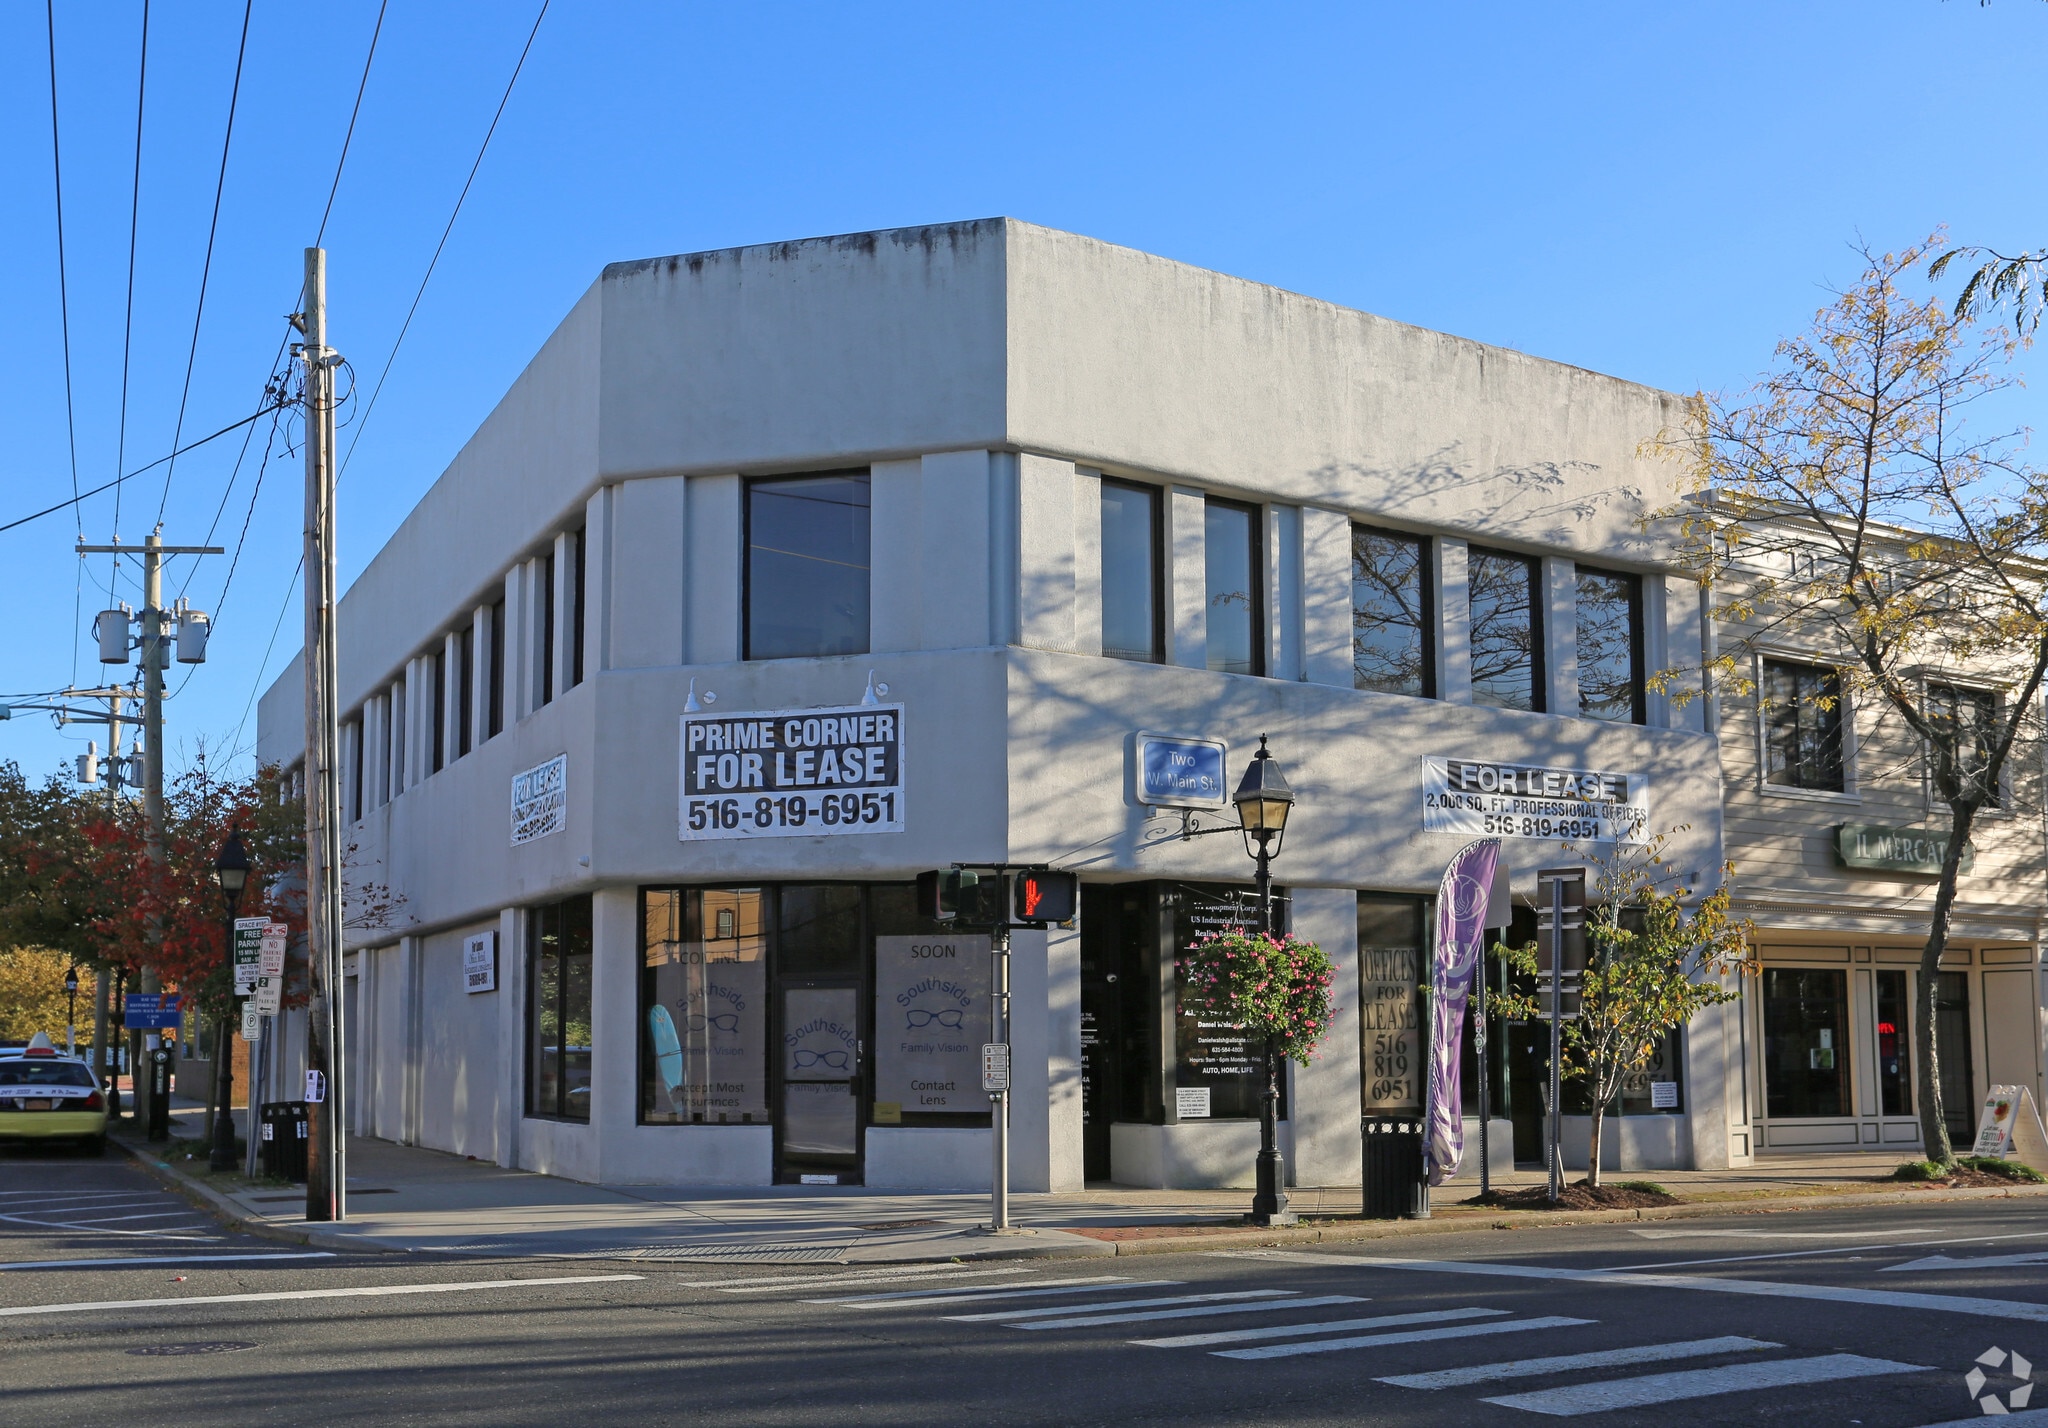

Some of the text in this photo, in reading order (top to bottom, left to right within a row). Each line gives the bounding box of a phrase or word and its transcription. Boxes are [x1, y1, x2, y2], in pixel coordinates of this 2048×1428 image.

[688, 714, 894, 751] PRIME CORNER
[696, 746, 886, 790] FOR LEASE
[1169, 751, 1196, 767] Two
[1147, 771, 1217, 791] W. Main St.
[1460, 765, 1617, 801] FOR LEASE
[688, 792, 895, 831] 516-819-6951
[1426, 793, 1648, 822] 2,000 SQ. FT. PROFESSIONAL OFFICES
[1484, 814, 1600, 839] 516-819-6951
[1856, 834, 1947, 864] IL MERCAT
[1191, 915, 1201, 923] US
[1202, 916, 1233, 925] Industrial
[244, 930, 261, 938] FREE
[238, 940, 261, 948] PARKIN
[269, 941, 278, 949] NO
[911, 944, 956, 959] SOON
[1365, 949, 1415, 982] OFFICES
[260, 978, 266, 987] 2
[896, 976, 971, 1008] Southside
[1377, 986, 1406, 1000] FOR
[1365, 1003, 1417, 1030] LEASE
[784, 1017, 856, 1048] Southside
[714, 1046, 744, 1056] Vision
[901, 1042, 969, 1055] Family Vision
[1374, 1034, 1408, 1055] 516
[1374, 1056, 1408, 1078] 819
[716, 1083, 744, 1093] Most
[787, 1083, 820, 1094] Family
[911, 1080, 956, 1091] Contact
[1371, 1080, 1413, 1101] 6951
[920, 1095, 947, 1105] Lens
[1981, 1129, 2006, 1142] family
